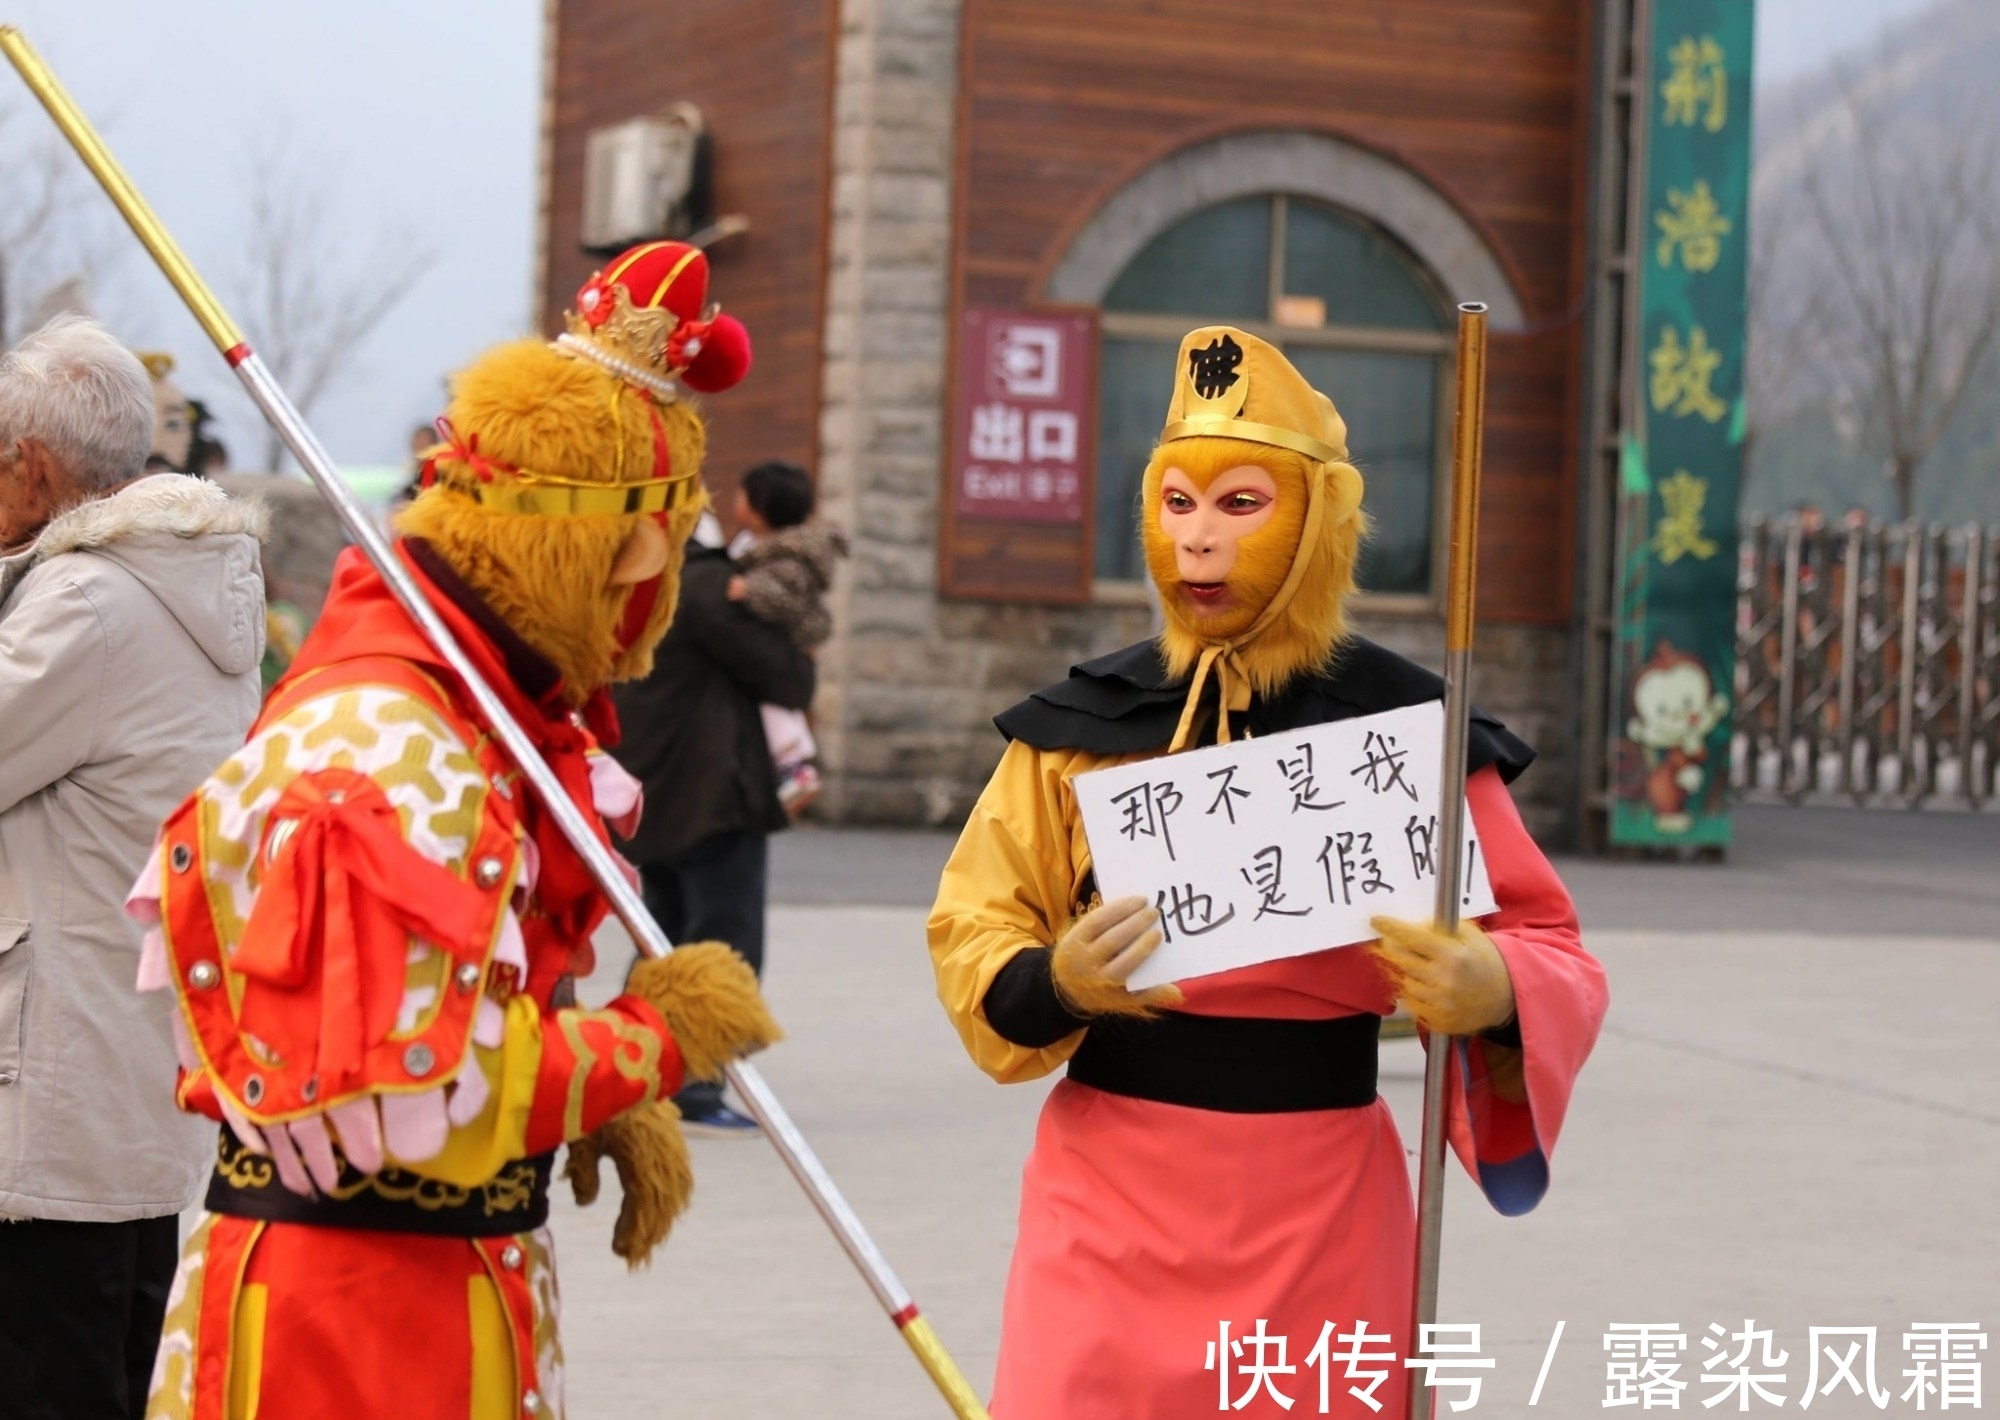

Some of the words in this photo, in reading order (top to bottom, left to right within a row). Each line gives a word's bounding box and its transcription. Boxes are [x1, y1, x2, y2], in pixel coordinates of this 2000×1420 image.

[969, 400, 1077, 463] 出口
[1110, 730, 1419, 862] 那不是我
